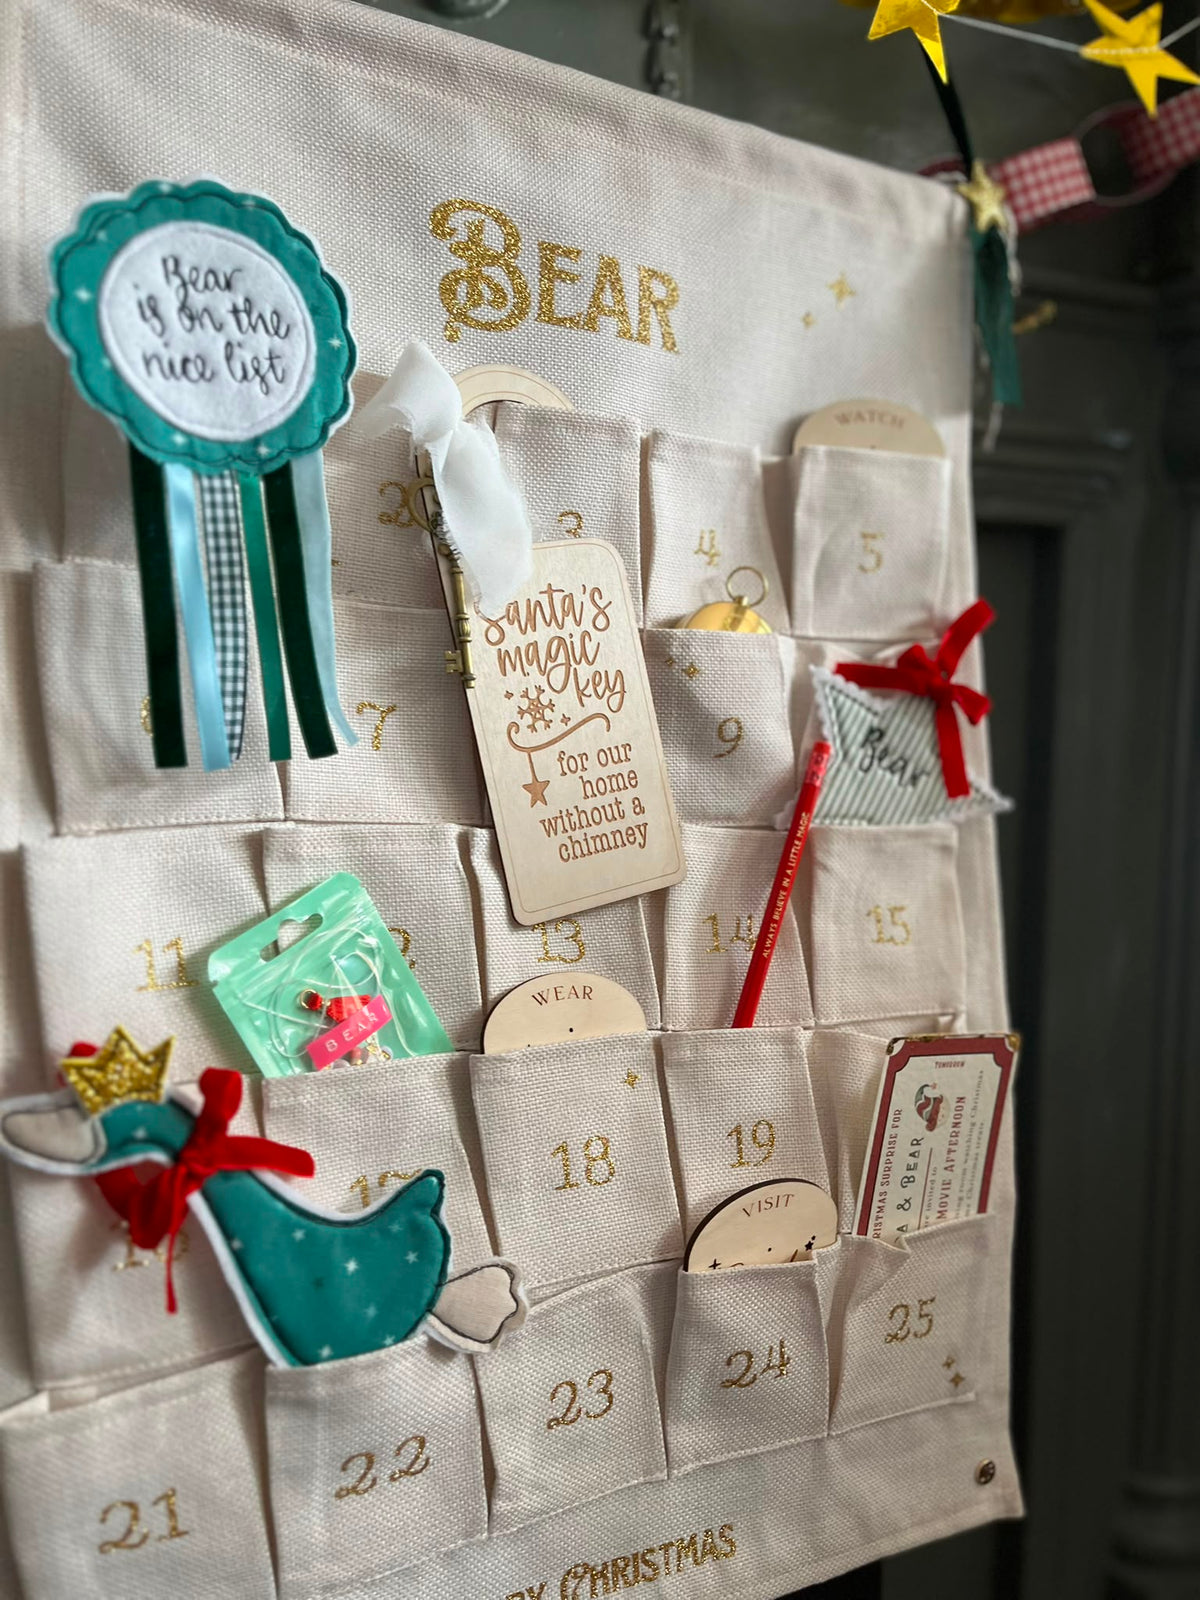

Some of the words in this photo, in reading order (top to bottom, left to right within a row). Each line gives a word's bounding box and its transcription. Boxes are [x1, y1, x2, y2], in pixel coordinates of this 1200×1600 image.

[162, 254, 242, 309] Bear
[133, 283, 166, 338] is
[178, 305, 224, 333] on
[227, 297, 290, 340] the
[142, 340, 216, 384] nice
[224, 340, 285, 396] list
[834, 409, 905, 429] WATCH
[694, 529, 721, 566] 4
[858, 531, 885, 573] 5
[496, 630, 601, 694] magic
[573, 667, 627, 713] key
[355, 700, 397, 751] 7
[712, 716, 745, 759] 9
[556, 750, 589, 777] for
[596, 742, 632, 768] our
[578, 769, 639, 800] home
[539, 796, 626, 839] without
[631, 796, 646, 816] a
[558, 822, 649, 863] chimney
[762, 923, 777, 958] ALWAYS
[773, 891, 787, 920] BELIEVE
[782, 877, 791, 889] IN
[789, 839, 802, 867] LITTLE
[797, 812, 810, 837] MAGIC
[531, 918, 586, 964] 13
[702, 912, 758, 953] 14
[866, 904, 912, 946] 15
[131, 936, 200, 992] 11
[531, 985, 593, 1006] WEAR
[325, 1012, 379, 1052] BEAR
[549, 1134, 617, 1192] 18
[725, 1119, 778, 1170] 19
[880, 1133, 898, 1187] SURPRISE
[892, 1109, 902, 1130] FOR
[900, 1137, 925, 1189] BEAR
[936, 1178, 952, 1220] MOVIE
[944, 1096, 966, 1173] AFTERNOON
[742, 1193, 795, 1217] VISIT
[897, 1196, 912, 1211] &
[883, 1297, 936, 1344] 25
[719, 1338, 793, 1389] 24
[545, 1368, 615, 1430] 23
[334, 1435, 432, 1499] 22
[97, 1486, 190, 1554] 21
[560, 1523, 737, 1600] CHRISTMAS
